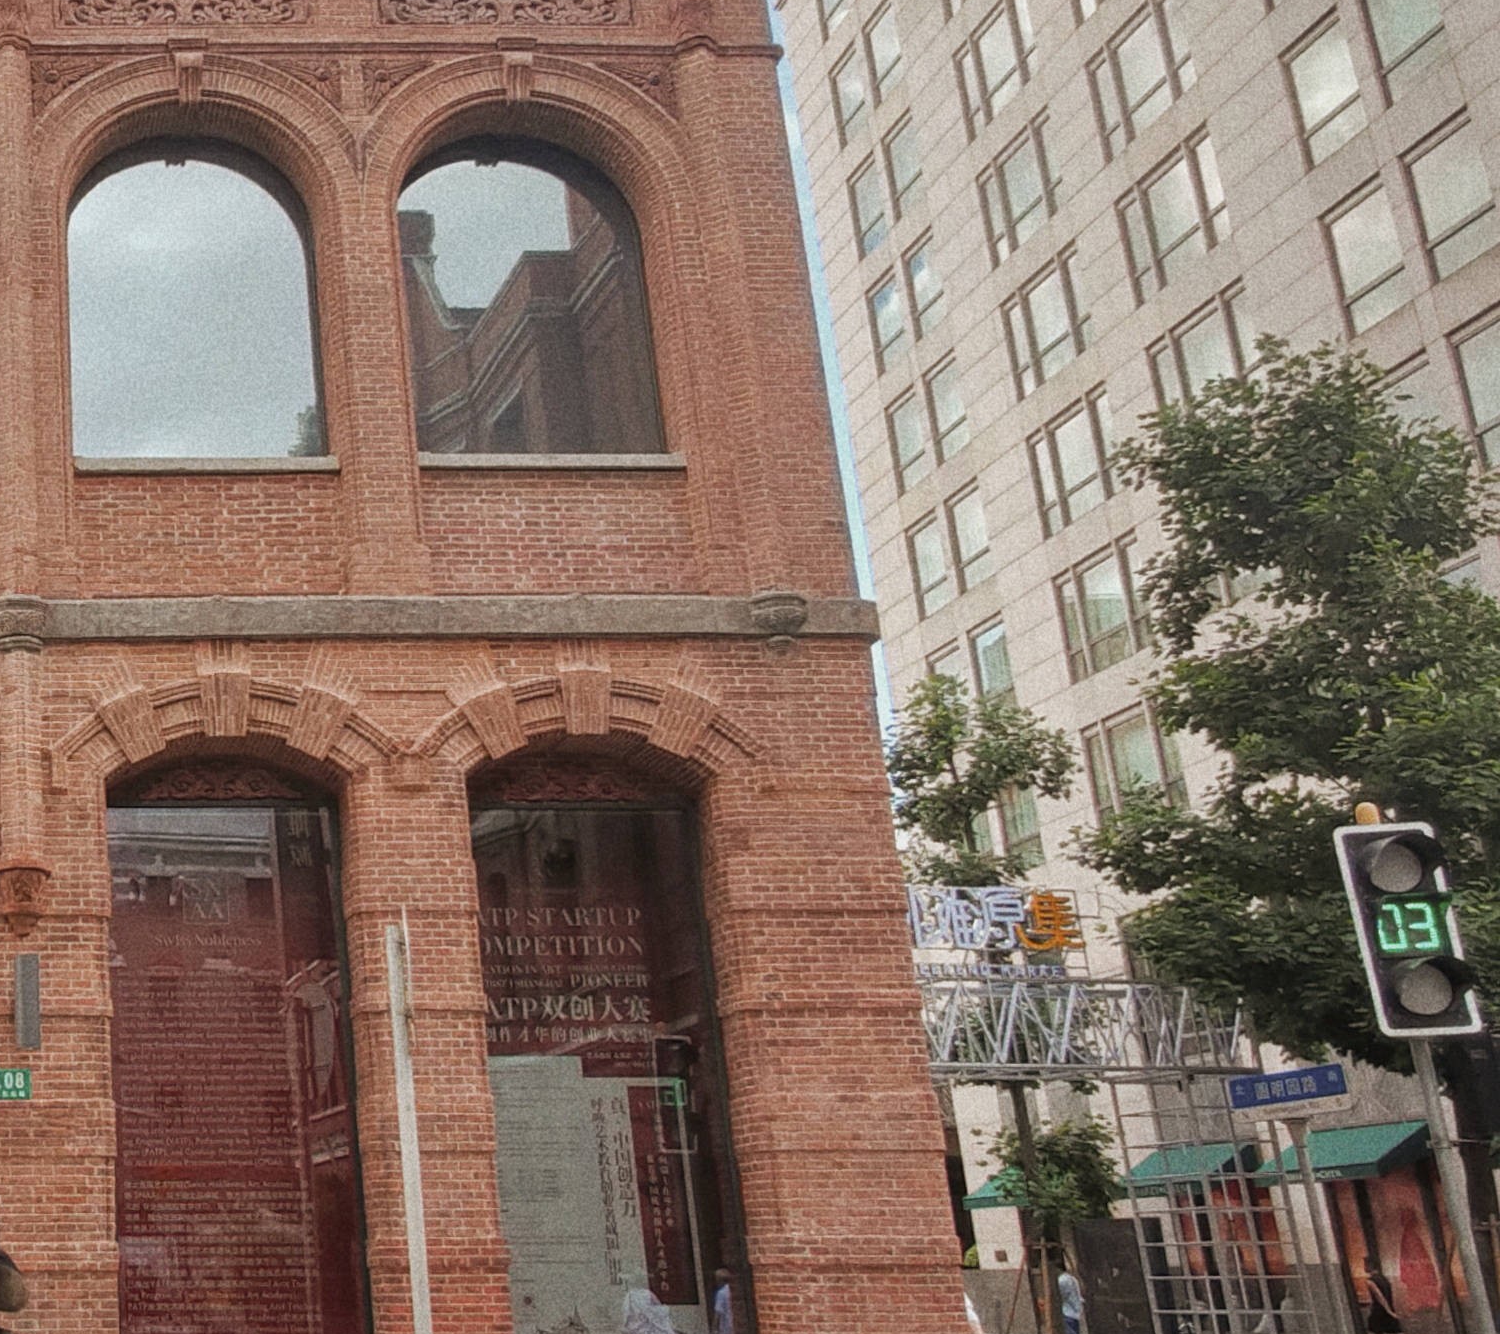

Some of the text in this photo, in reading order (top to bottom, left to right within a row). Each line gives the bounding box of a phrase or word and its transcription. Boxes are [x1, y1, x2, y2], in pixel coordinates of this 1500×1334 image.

[478, 906, 642, 927] ATP STARTUP
[1378, 902, 1440, 951] 03
[569, 973, 650, 988] PIONEER
[486, 994, 652, 1024] ATP双创大赛
